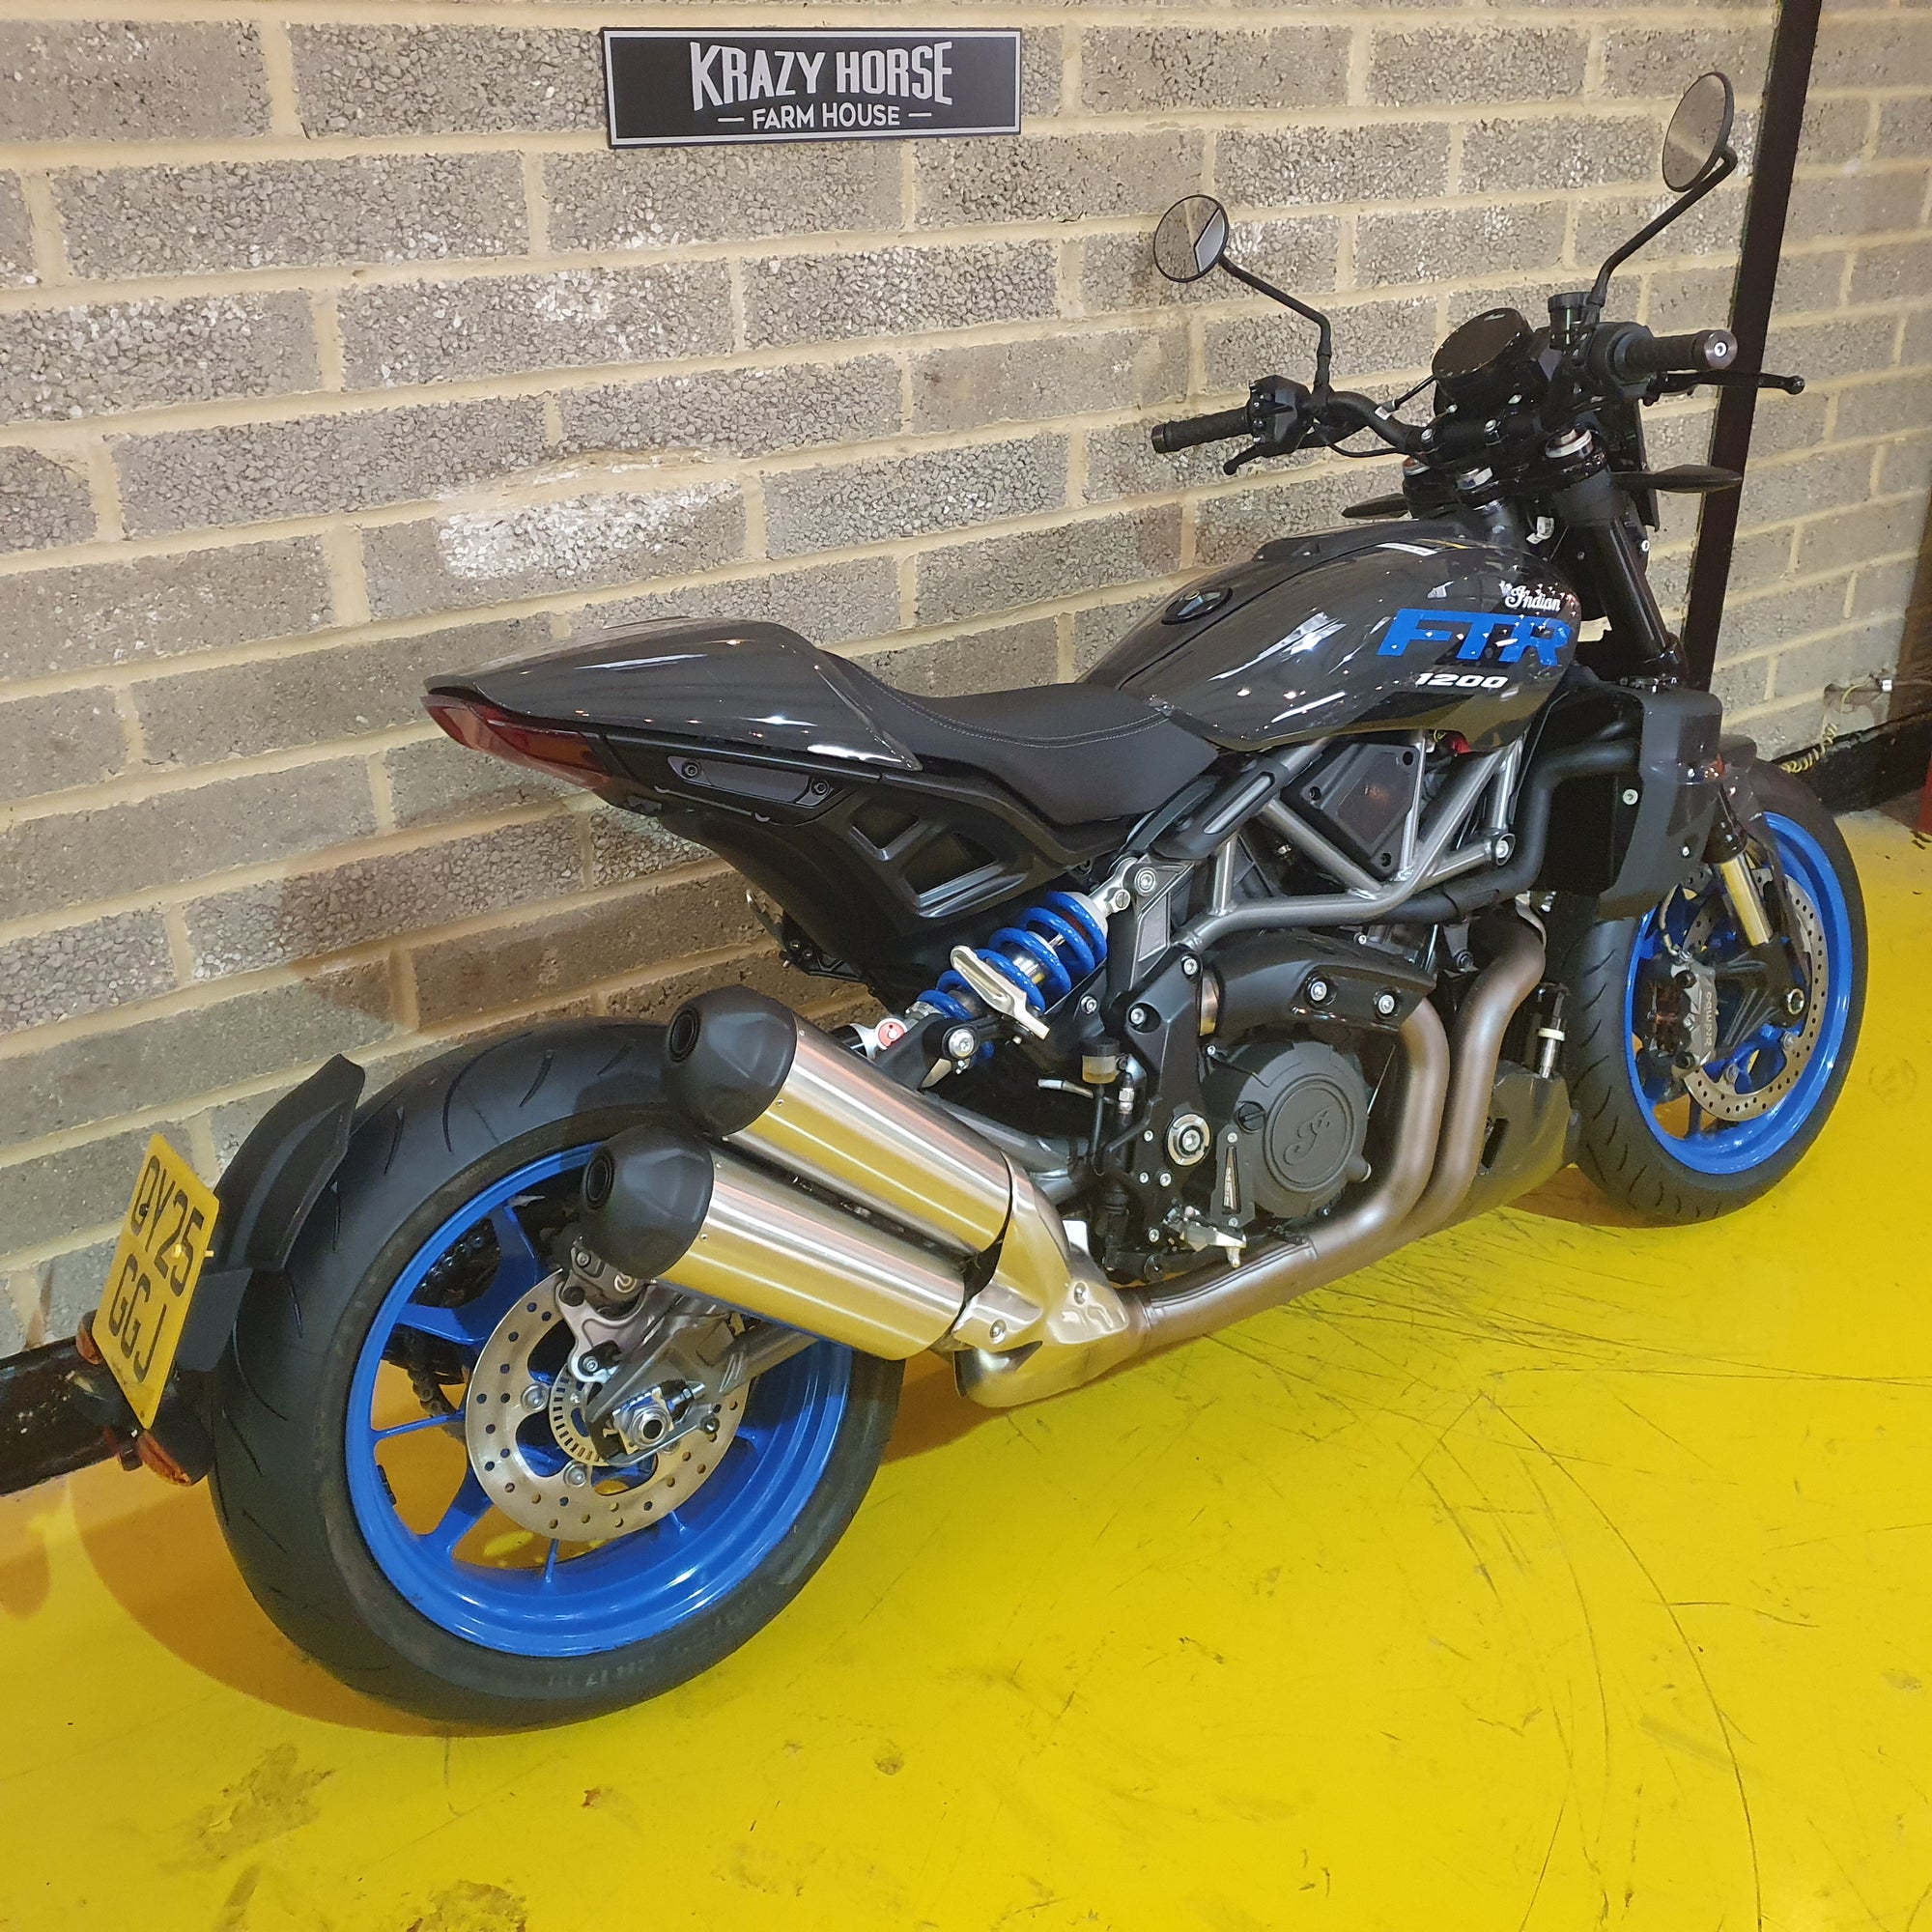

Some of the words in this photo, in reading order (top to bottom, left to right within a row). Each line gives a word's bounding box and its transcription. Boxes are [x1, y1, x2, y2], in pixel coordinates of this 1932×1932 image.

[690, 42, 826, 111] KRAZY
[836, 42, 953, 105] HORSE
[753, 104, 814, 129] FARM
[822, 102, 900, 127] HOUSE
[1504, 584, 1561, 611] Indian
[1376, 608, 1573, 667] FTR
[1415, 672, 1509, 688] 1200
[107, 1253, 167, 1383] GGJ
